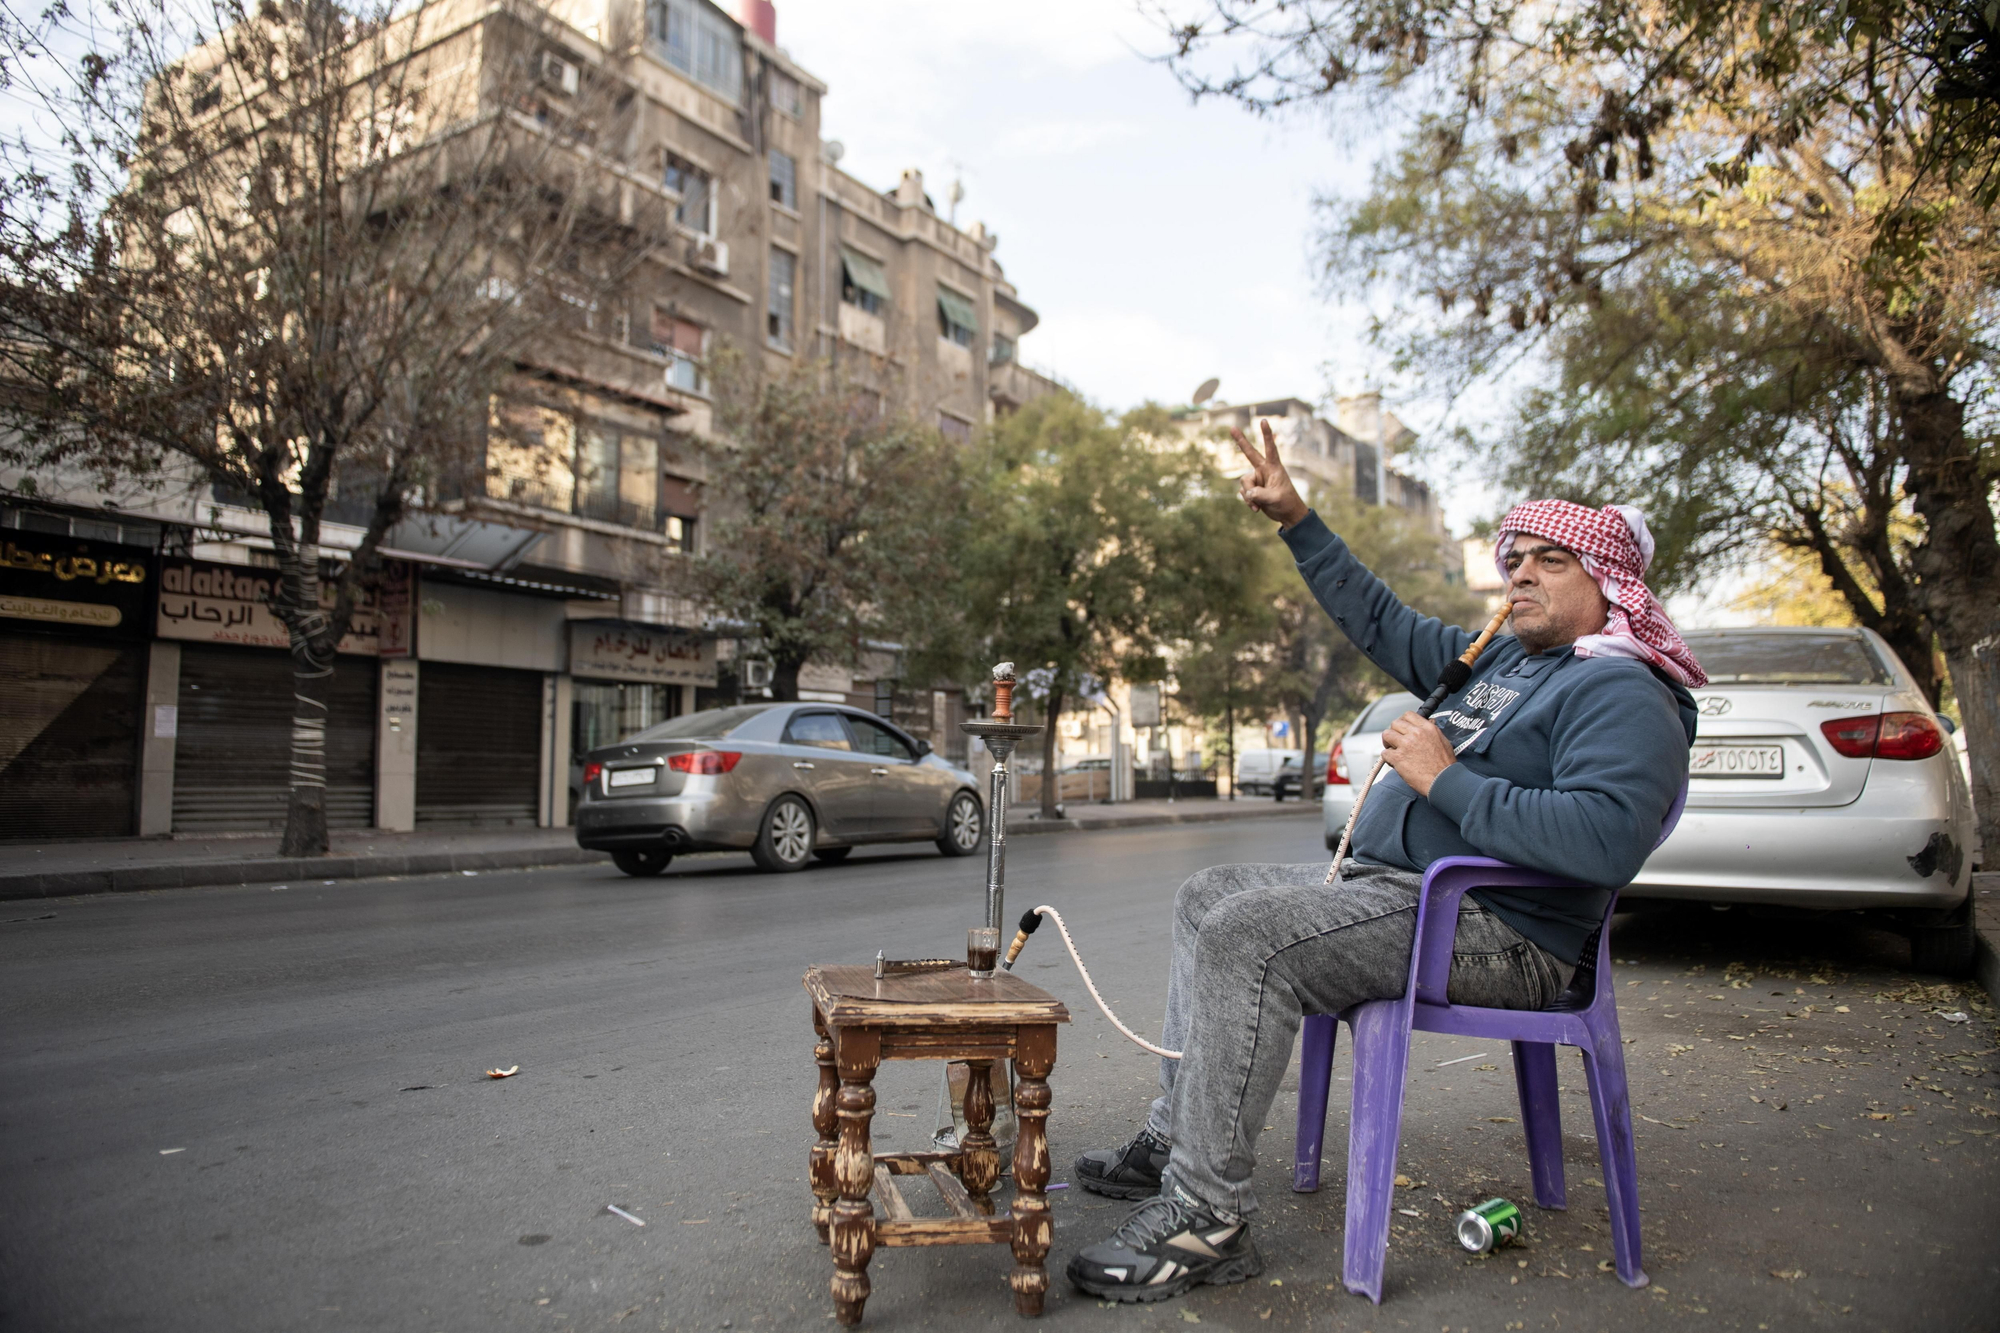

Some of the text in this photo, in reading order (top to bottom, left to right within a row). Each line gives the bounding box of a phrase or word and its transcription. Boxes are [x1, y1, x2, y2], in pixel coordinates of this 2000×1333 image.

[0, 541, 146, 585] معرض عط
[161, 599, 252, 629] الرحاب
[1807, 700, 1873, 711] AVANTE
[1175, 1185, 1200, 1208] Reebok
